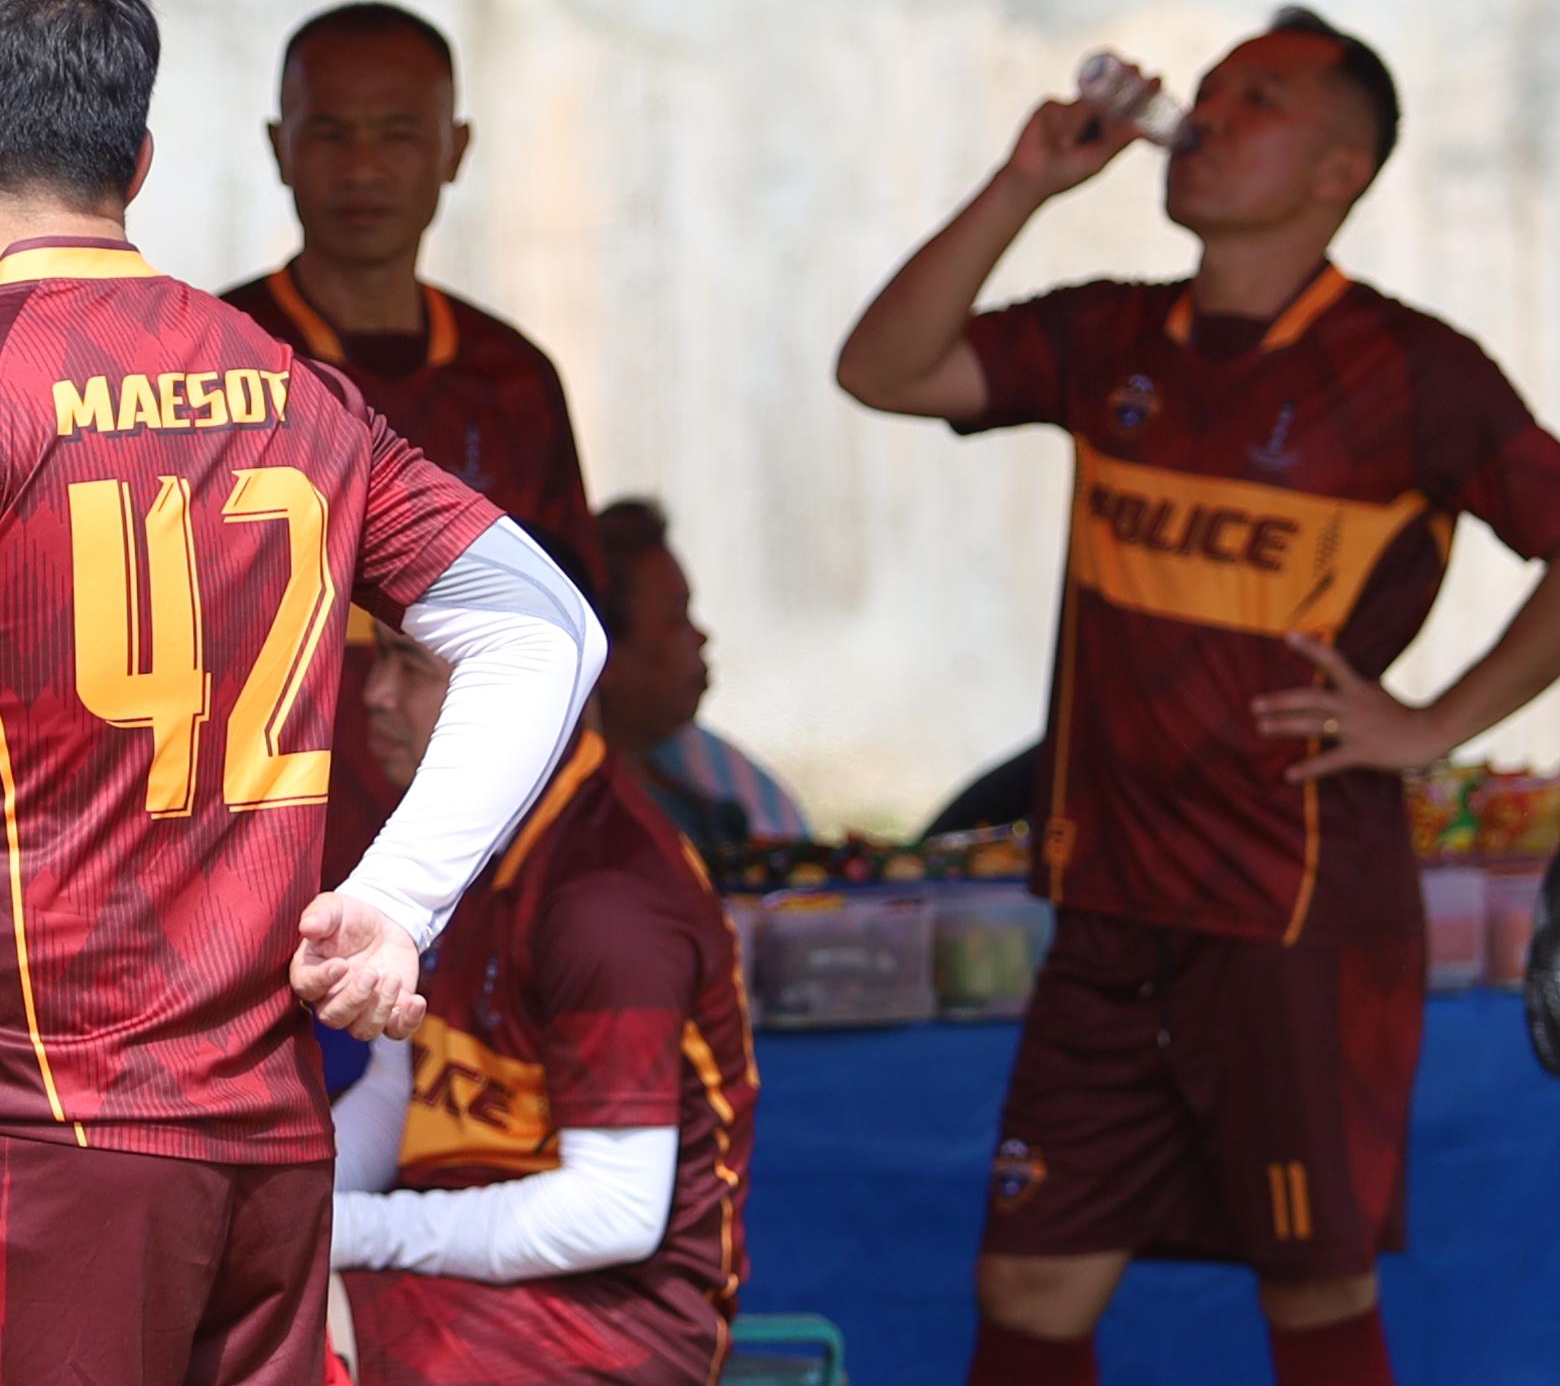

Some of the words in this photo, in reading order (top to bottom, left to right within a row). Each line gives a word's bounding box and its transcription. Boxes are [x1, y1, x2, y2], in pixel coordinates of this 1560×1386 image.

[52, 368, 291, 439] MAESOT
[1089, 483, 1301, 573] POLICE
[68, 466, 332, 820] 42
